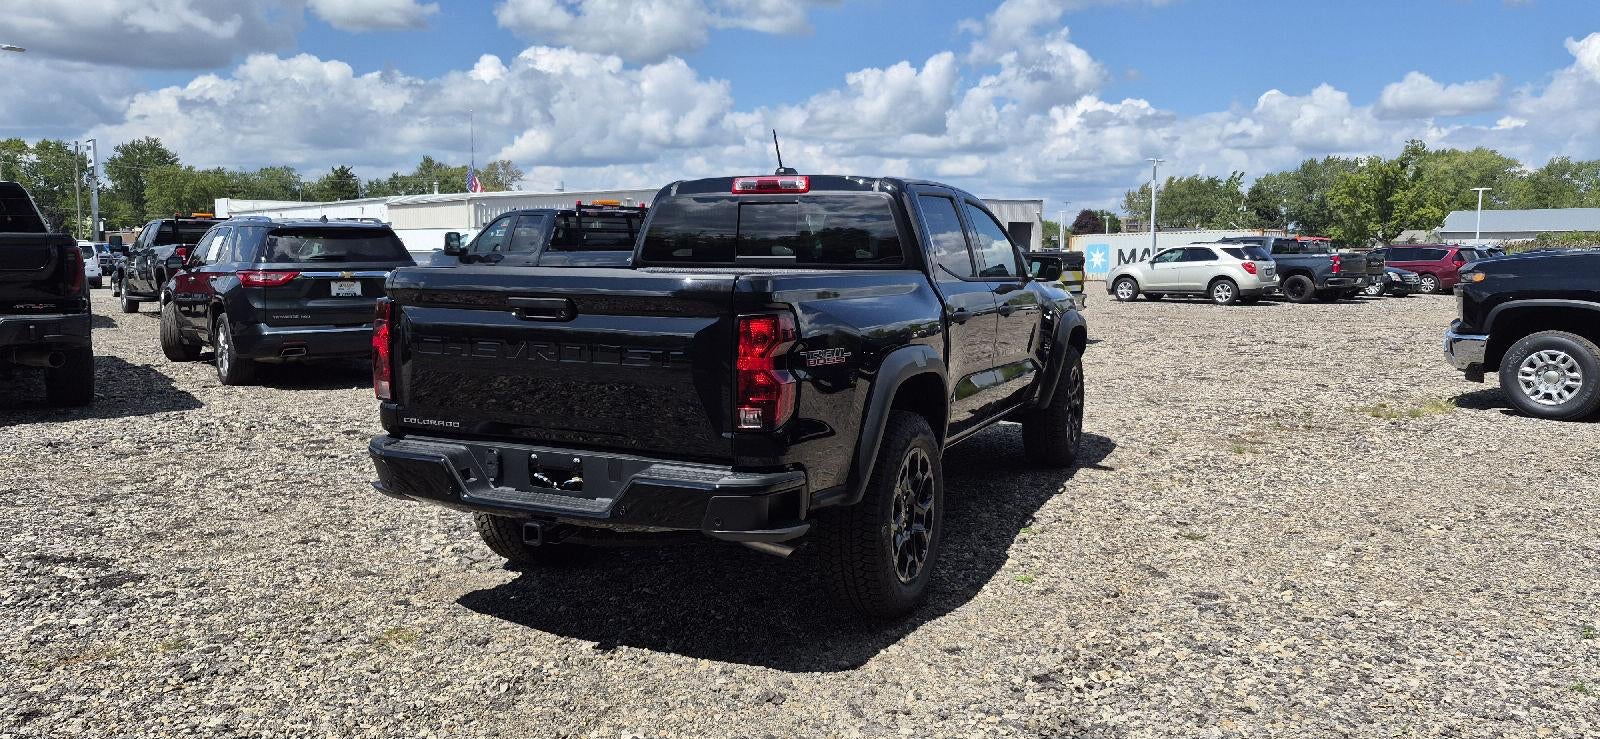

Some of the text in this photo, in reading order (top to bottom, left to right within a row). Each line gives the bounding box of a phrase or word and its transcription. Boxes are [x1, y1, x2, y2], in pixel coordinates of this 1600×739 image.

[416, 336, 688, 368] CHEVROLET
[799, 347, 852, 360] TRAIL
[806, 356, 846, 367] BOSS
[403, 416, 460, 429] COLORADO
